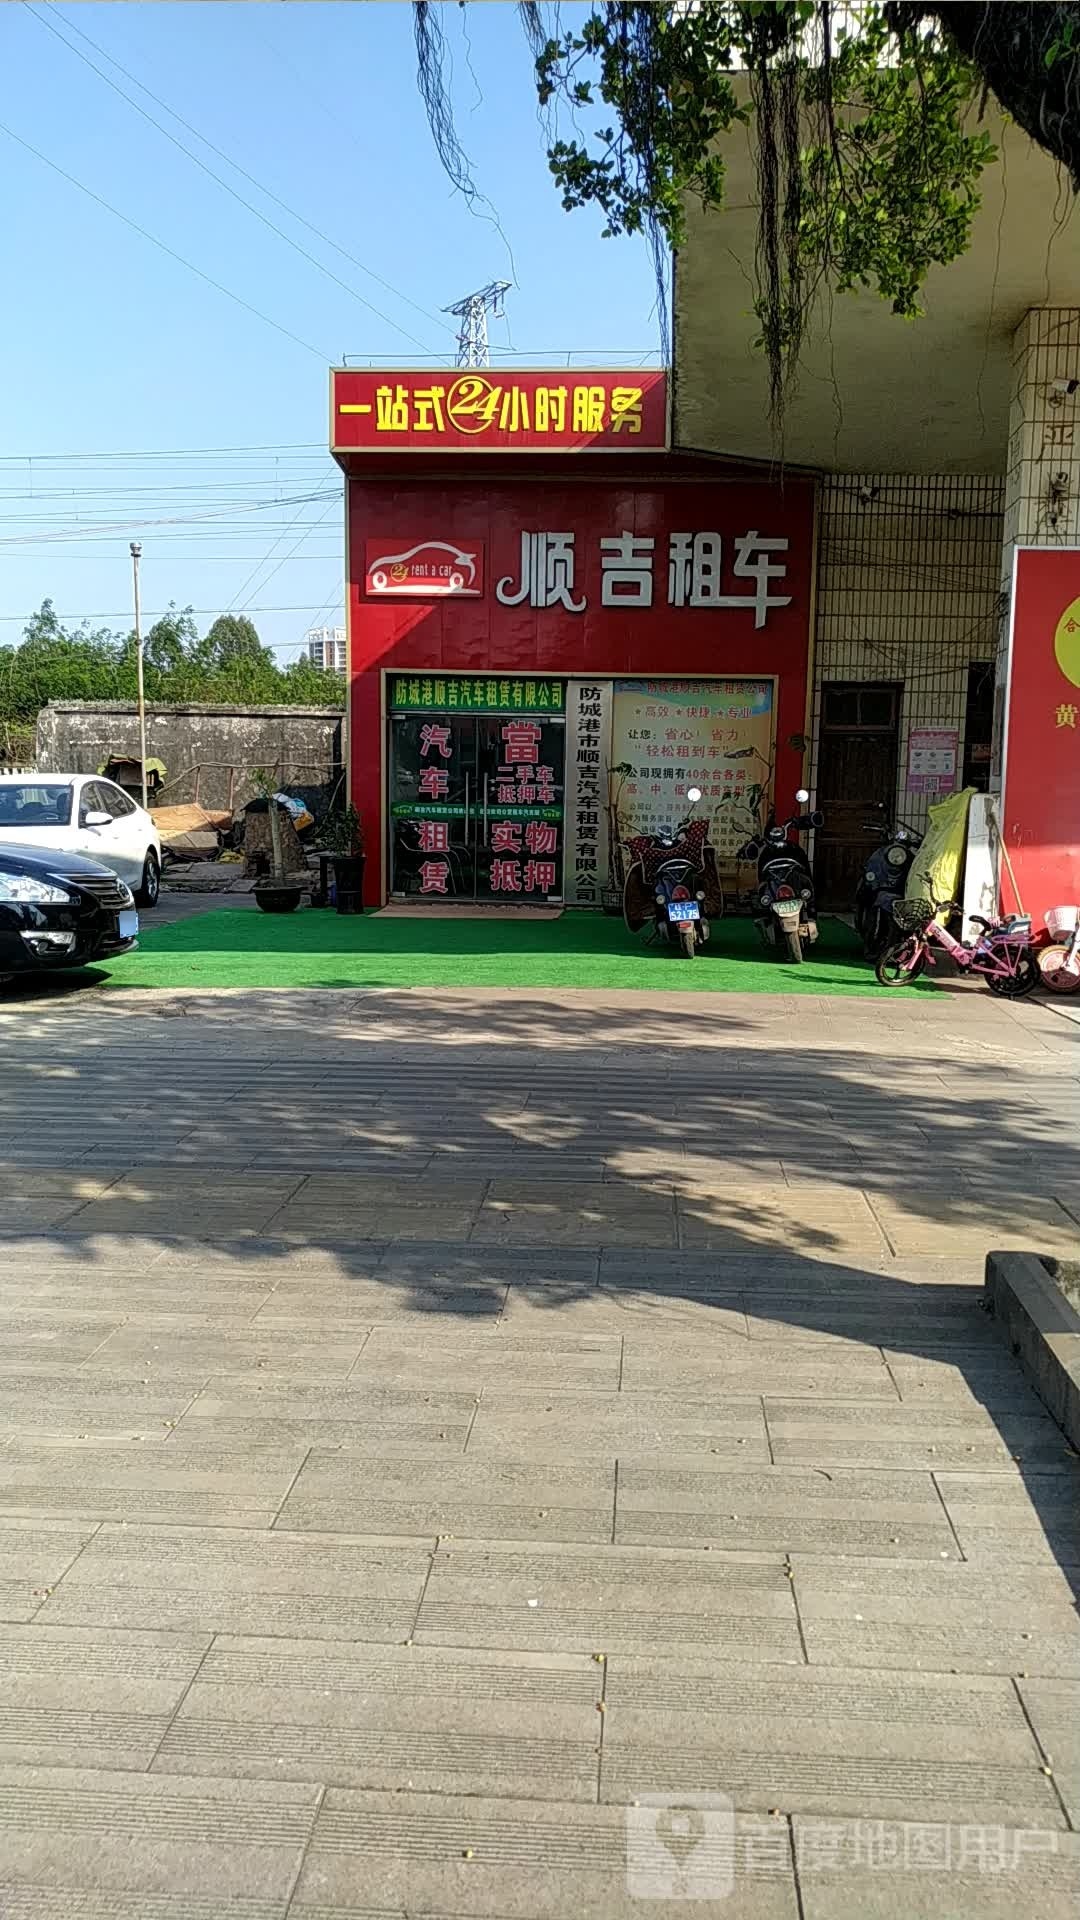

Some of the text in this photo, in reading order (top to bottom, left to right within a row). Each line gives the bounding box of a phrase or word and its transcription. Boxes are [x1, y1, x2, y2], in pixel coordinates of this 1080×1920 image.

[339, 376, 643, 434] 一站式24小时服务
[411, 565, 428, 576] rent
[431, 567, 436, 576] a
[438, 566, 452, 576] car
[496, 530, 793, 630] 顺吉租车
[395, 679, 562, 708] 防城港顺吉汽车租赁有限公司
[502, 721, 541, 763] 當
[496, 765, 554, 784] 二手车
[498, 785, 555, 804] 抵押车
[575, 686, 602, 902] 防城港市顺吉汽车租赁有限公司
[492, 821, 557, 853] 实物
[490, 859, 556, 893] 抵押
